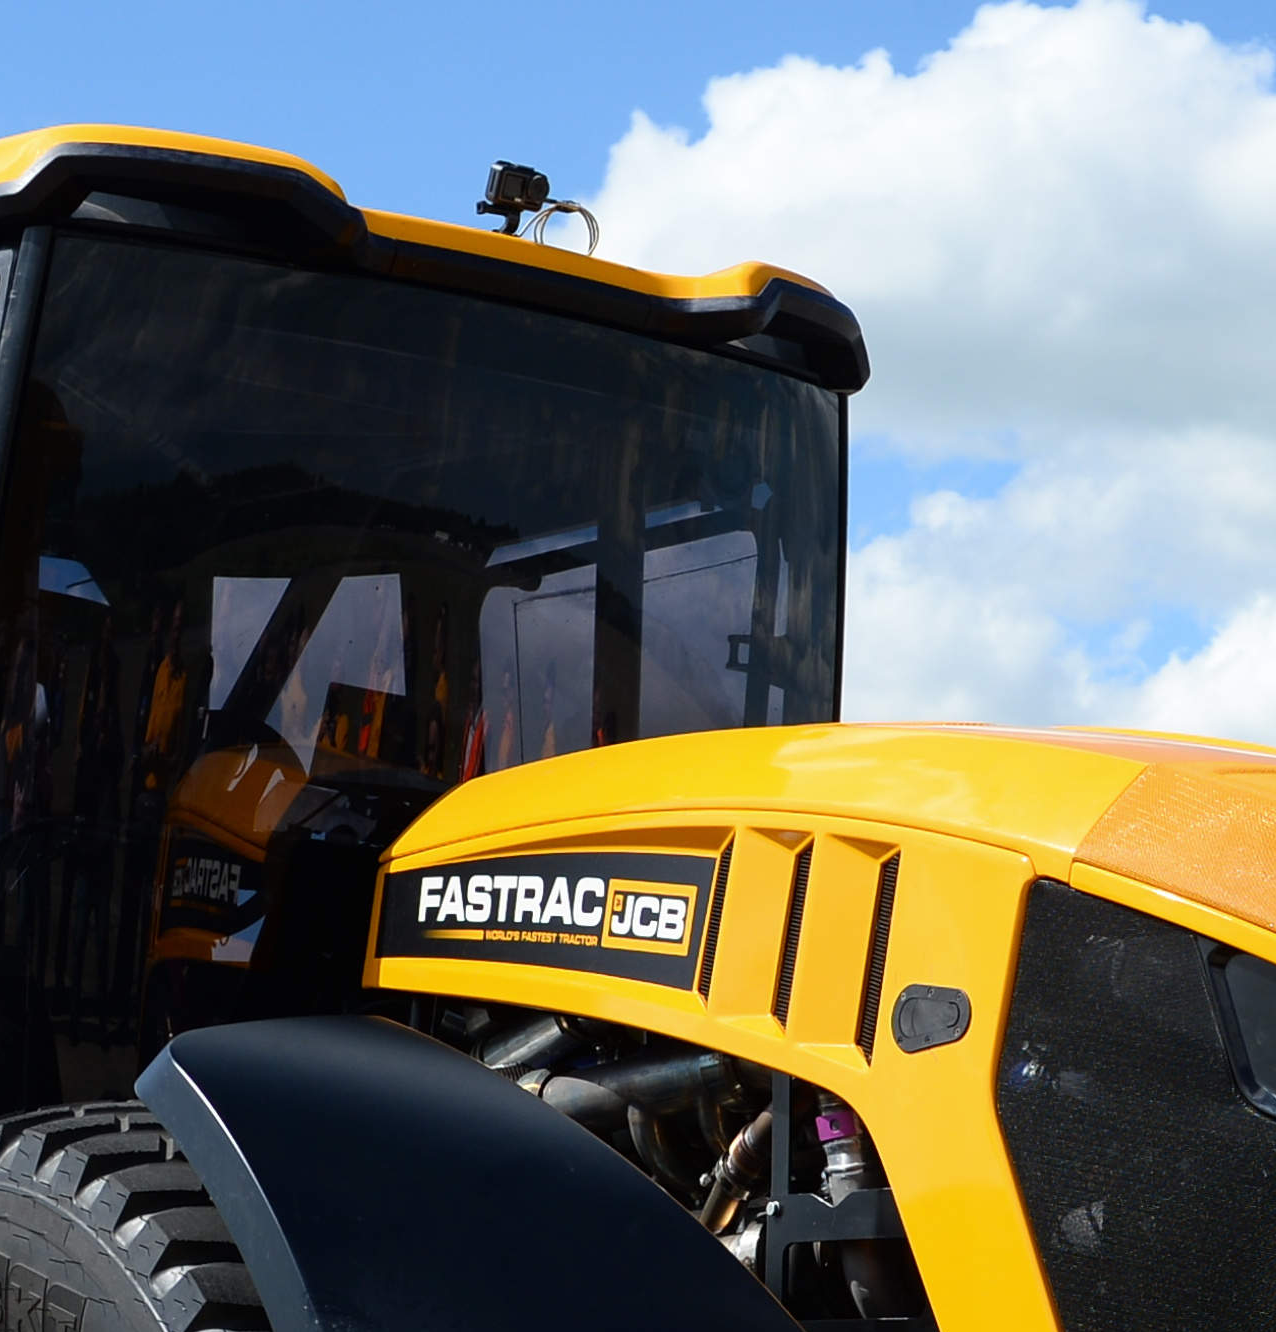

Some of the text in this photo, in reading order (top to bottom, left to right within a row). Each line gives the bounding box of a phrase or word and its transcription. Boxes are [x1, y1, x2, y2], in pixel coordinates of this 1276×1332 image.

[417, 875, 687, 940] FASTRAC JCB
[485, 930, 598, 947] WORLD'S FASTEST TRACTOR
